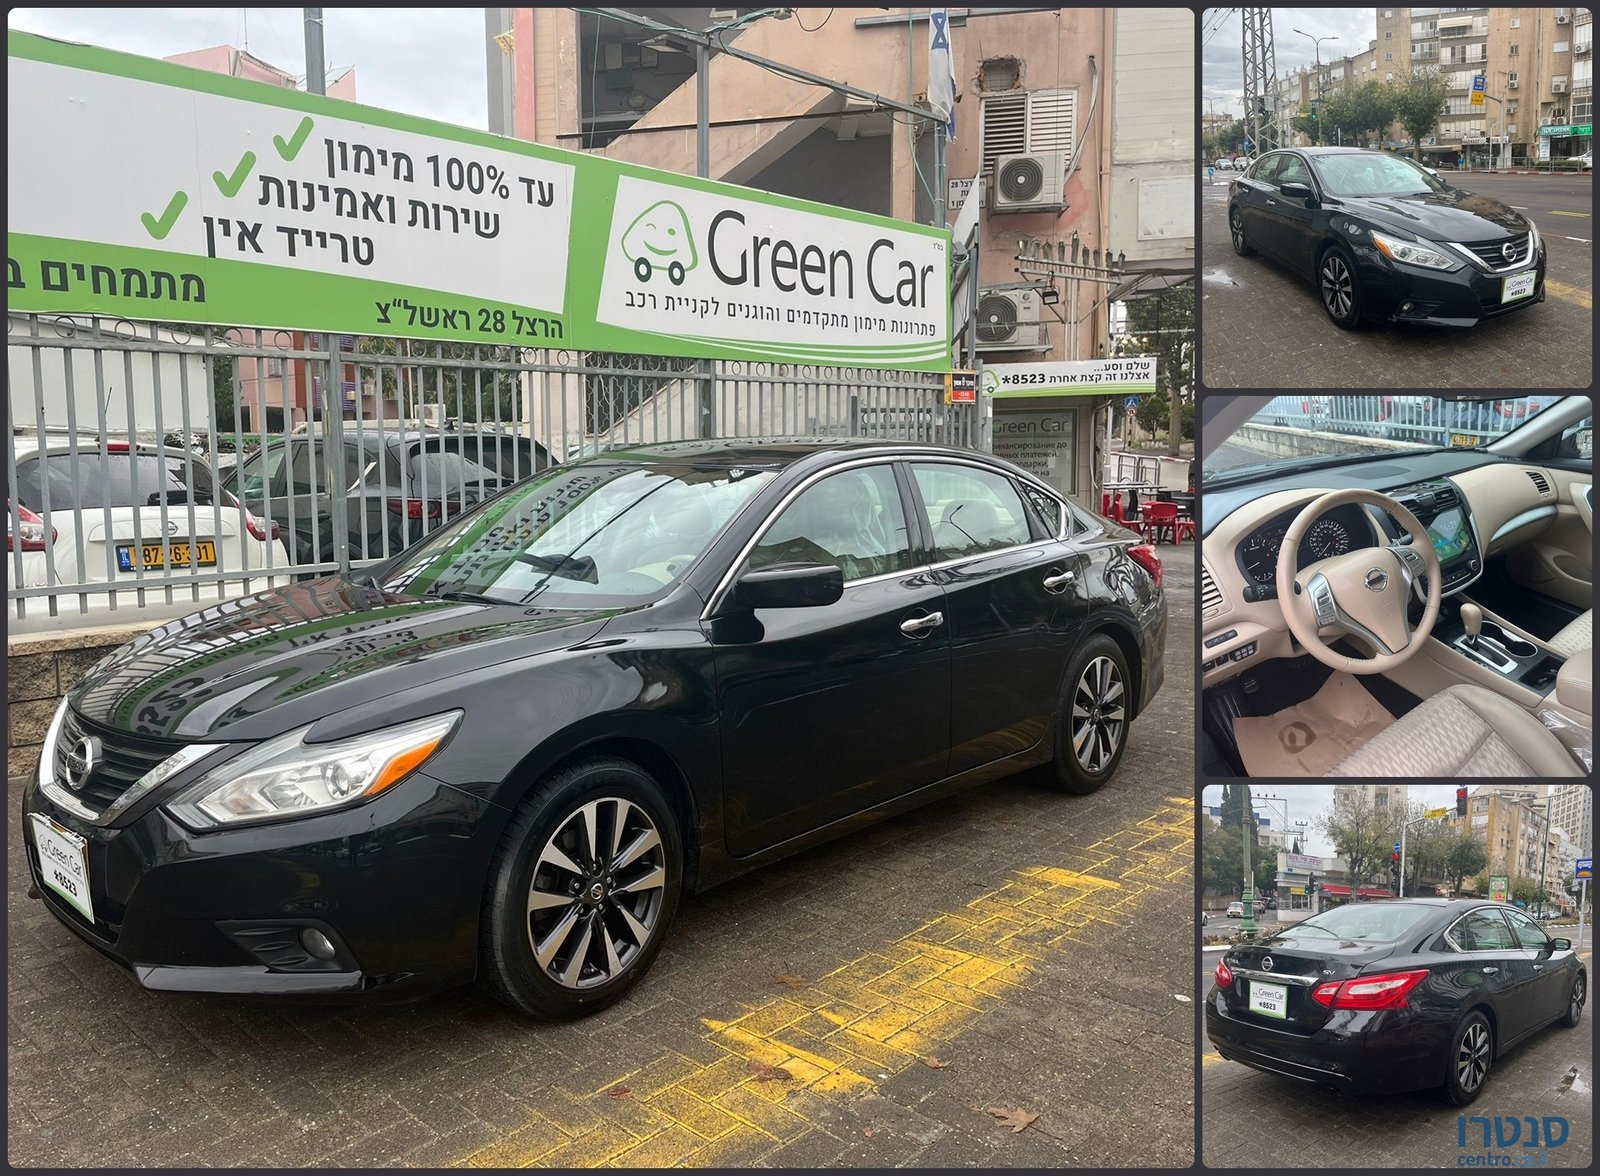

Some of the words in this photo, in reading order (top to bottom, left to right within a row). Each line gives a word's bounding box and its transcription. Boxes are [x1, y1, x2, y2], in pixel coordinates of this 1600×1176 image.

[324, 138, 414, 182] מימון
[427, 154, 510, 200] 100%
[258, 175, 396, 224] ואמינות
[518, 176, 554, 207] עד
[408, 199, 500, 239] שירות
[203, 216, 264, 258] אין
[276, 225, 375, 266] טרייד
[707, 209, 854, 300] Green
[866, 238, 934, 308] Car
[40, 260, 206, 303] מתמחים
[625, 291, 657, 309] רכב
[664, 295, 720, 319] לקניית
[478, 308, 506, 333] 28
[727, 302, 780, 322] והוגנים
[787, 308, 849, 329] מתקדמים
[511, 310, 564, 338] הרצל
[854, 315, 886, 332] מימון
[890, 319, 936, 336] פתרונות
[1105, 373, 1117, 381] זה
[1120, 371, 1150, 381] אצלנו
[1126, 361, 1150, 371] שלם
[1049, 373, 1077, 384] אחרת
[1080, 374, 1102, 383] קצת
[1041, 417, 1068, 432] Car
[1056, 441, 1067, 450] до
[47, 839, 70, 868] Green
[68, 854, 82, 876] Car
[1258, 988, 1275, 998] Green
[1274, 992, 1285, 1001] Car
